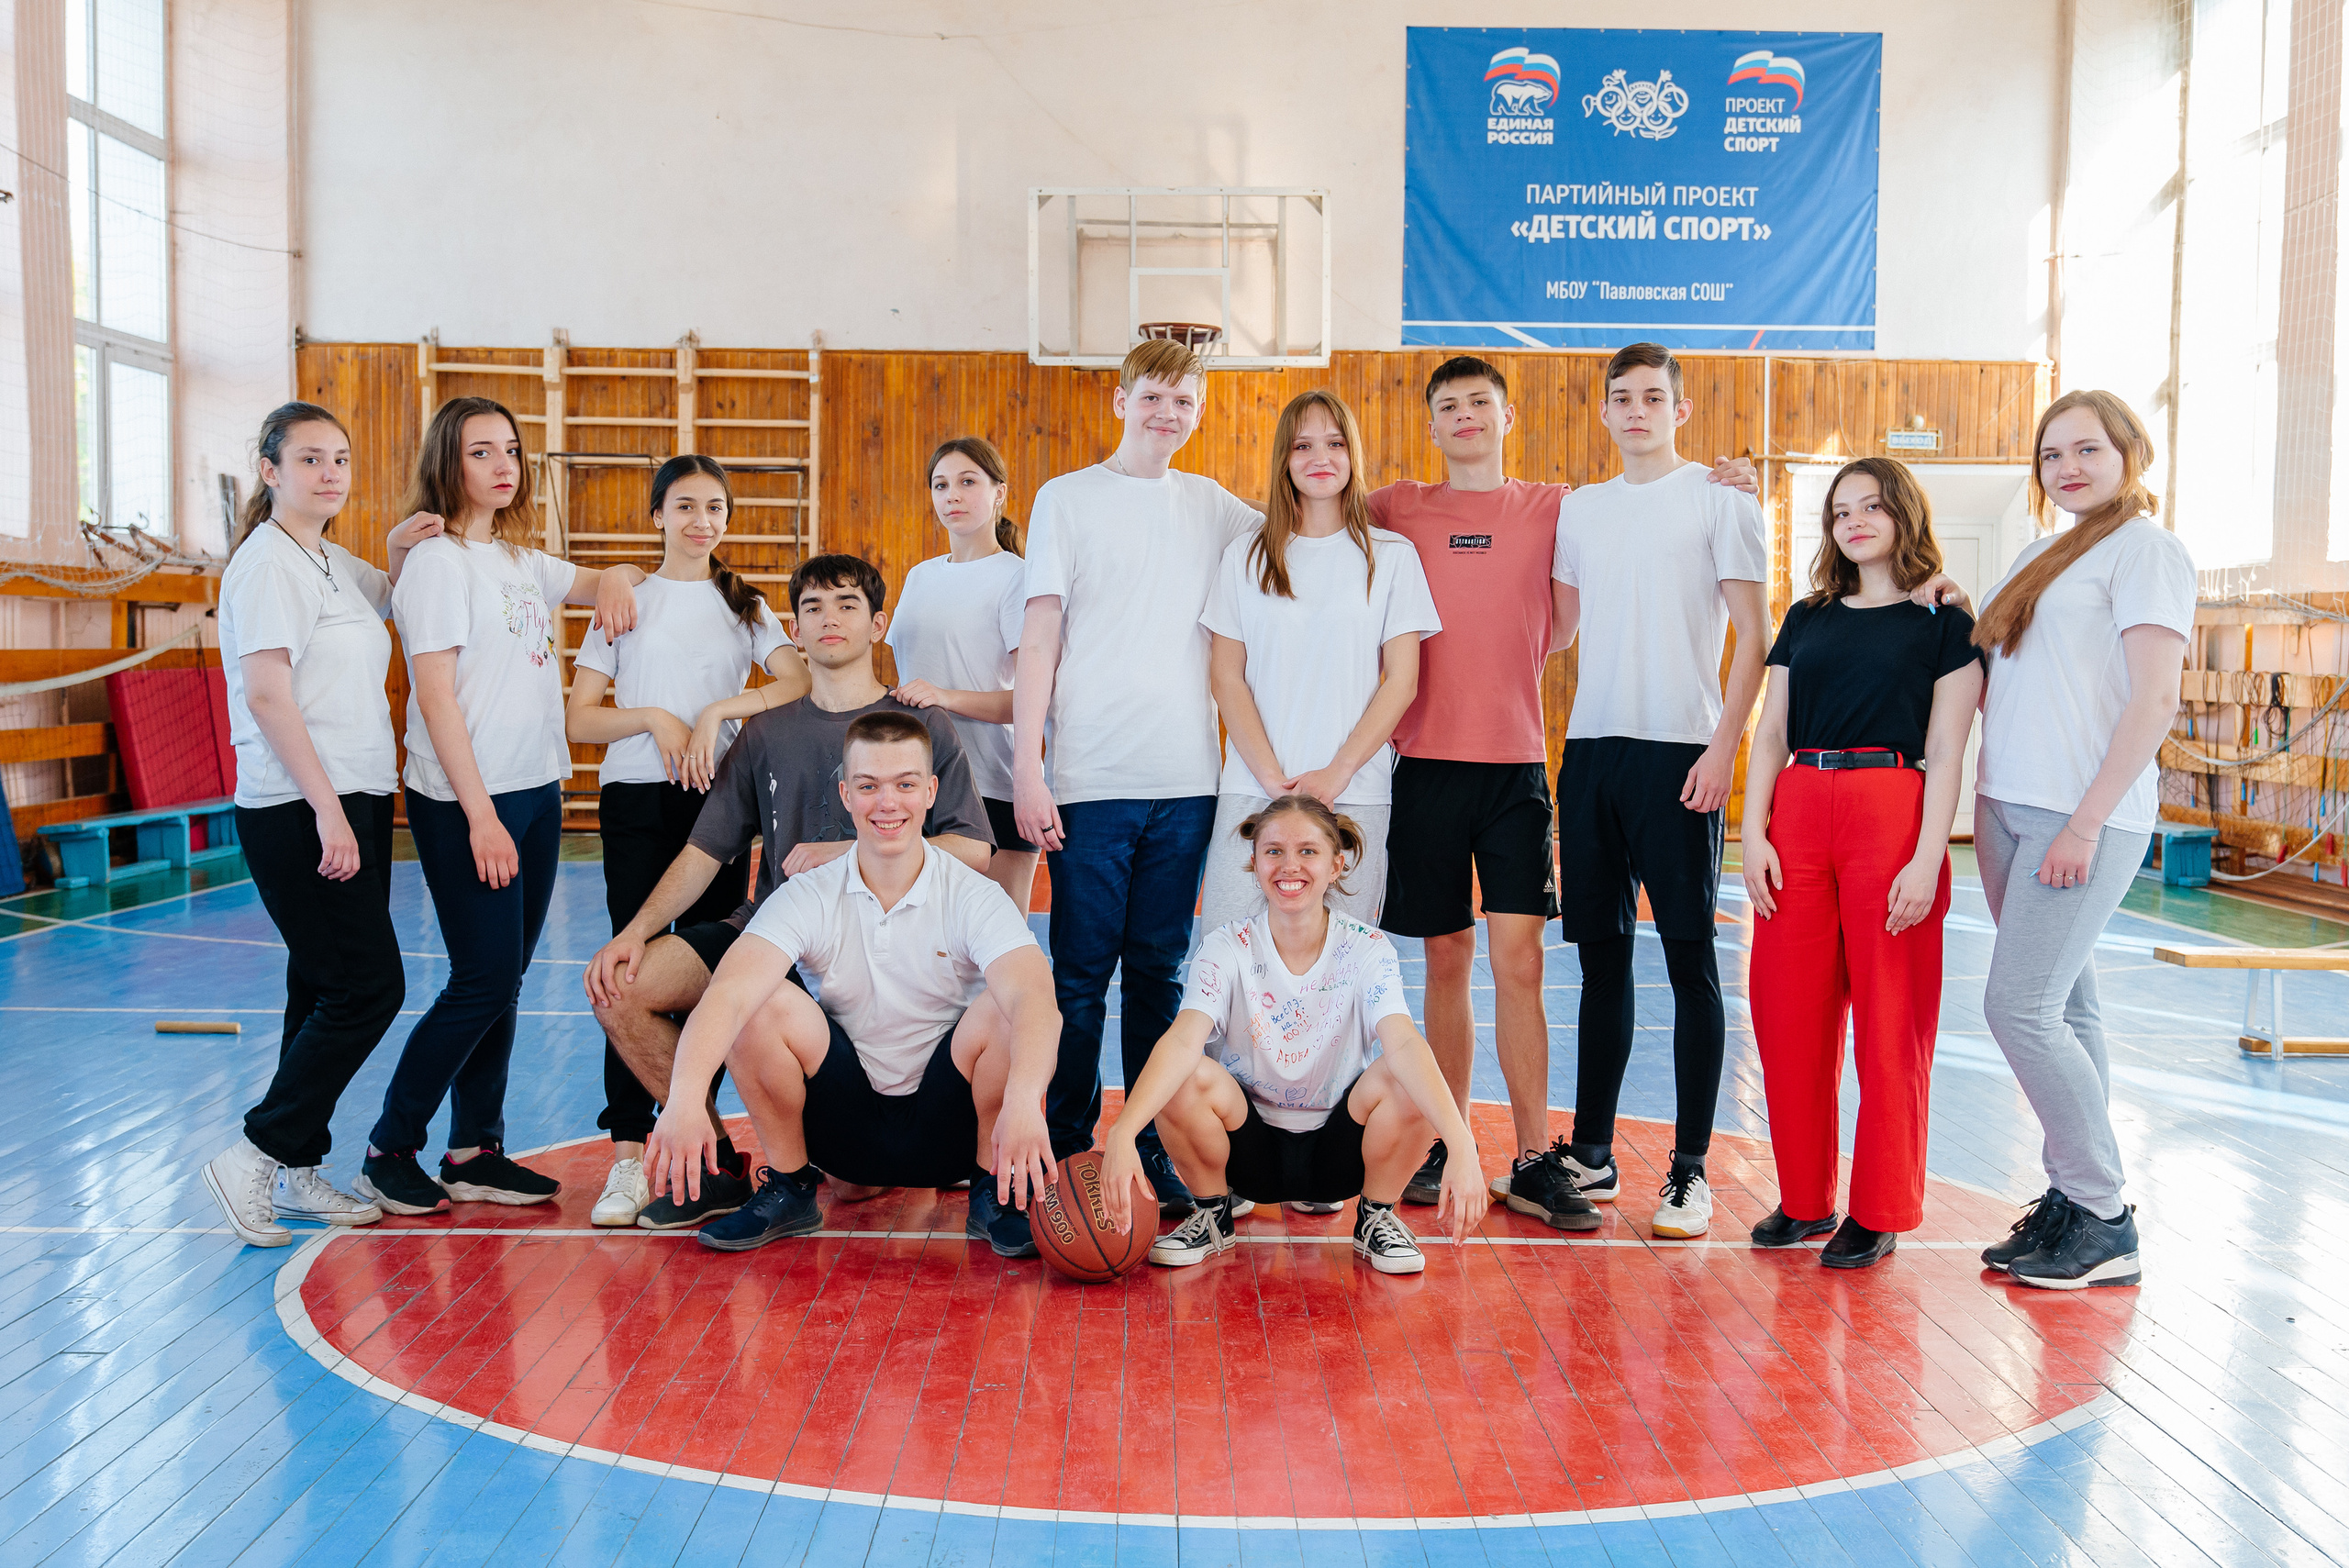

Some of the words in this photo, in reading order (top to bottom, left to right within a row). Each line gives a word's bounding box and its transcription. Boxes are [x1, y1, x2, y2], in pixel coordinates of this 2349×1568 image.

[1725, 97, 1786, 114] ПРОЕКТ
[1487, 117, 1553, 130] ЕДИНАЯ
[1723, 115, 1801, 134] ДЕТСКИЙ
[1487, 131, 1553, 144] РОССИЯ
[1723, 137, 1779, 152] СПОРТ
[1526, 181, 1665, 206] ПАРТИЙНЫЙ
[1673, 185, 1759, 206] ПРОЕКТ
[1510, 210, 1656, 243] «ДЕТСКИЙ
[1664, 216, 1772, 240] СПОРТ»
[1546, 281, 1587, 299] МБОУ
[1044, 1183, 1060, 1213] BM
[1050, 1209, 1075, 1245] 900
